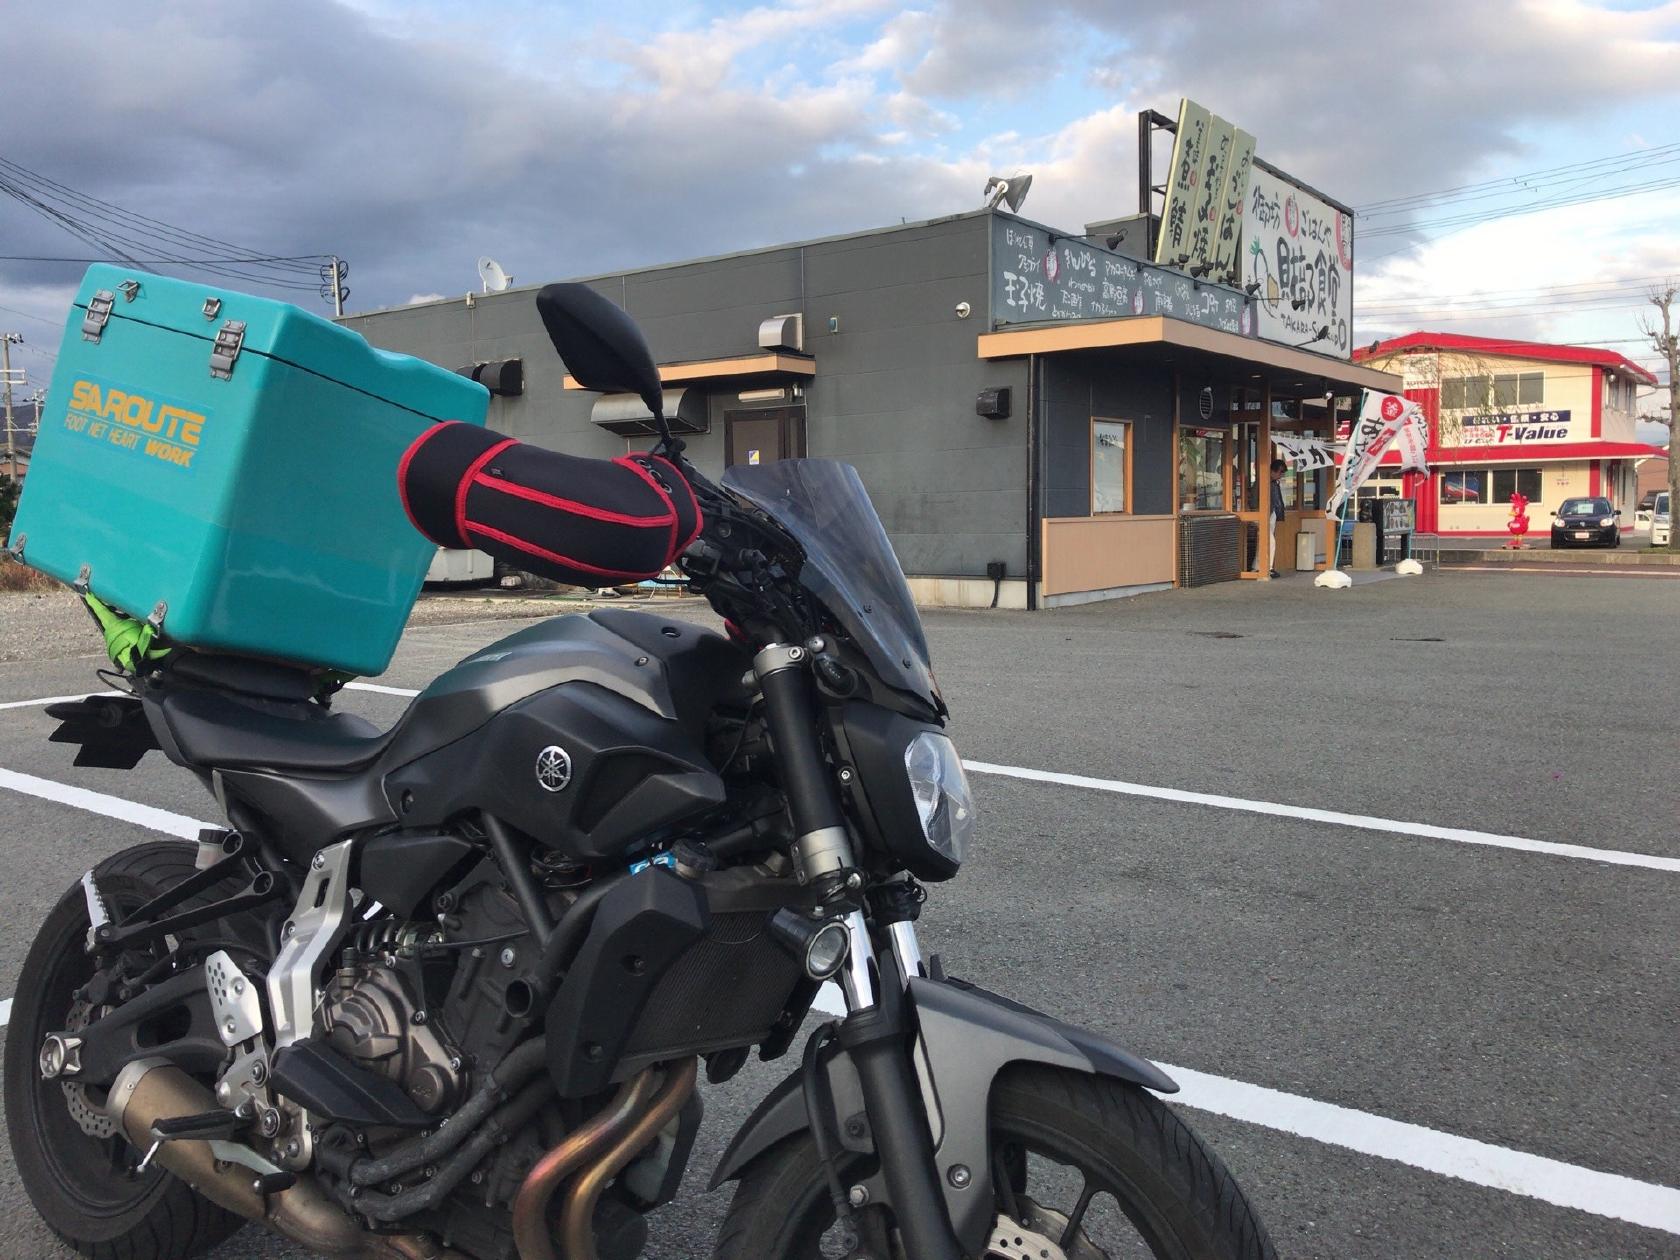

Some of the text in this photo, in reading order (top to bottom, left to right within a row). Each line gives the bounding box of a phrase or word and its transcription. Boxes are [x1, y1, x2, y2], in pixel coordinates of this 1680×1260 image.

[1064, 248, 1097, 277] きんぴら
[1003, 270, 1048, 313] 玉子焼
[69, 380, 206, 445] SAROUTE
[1496, 424, 1568, 443] T-Value
[64, 412, 88, 433] FOOT
[107, 427, 144, 450] HEART
[144, 437, 195, 468] WORK
